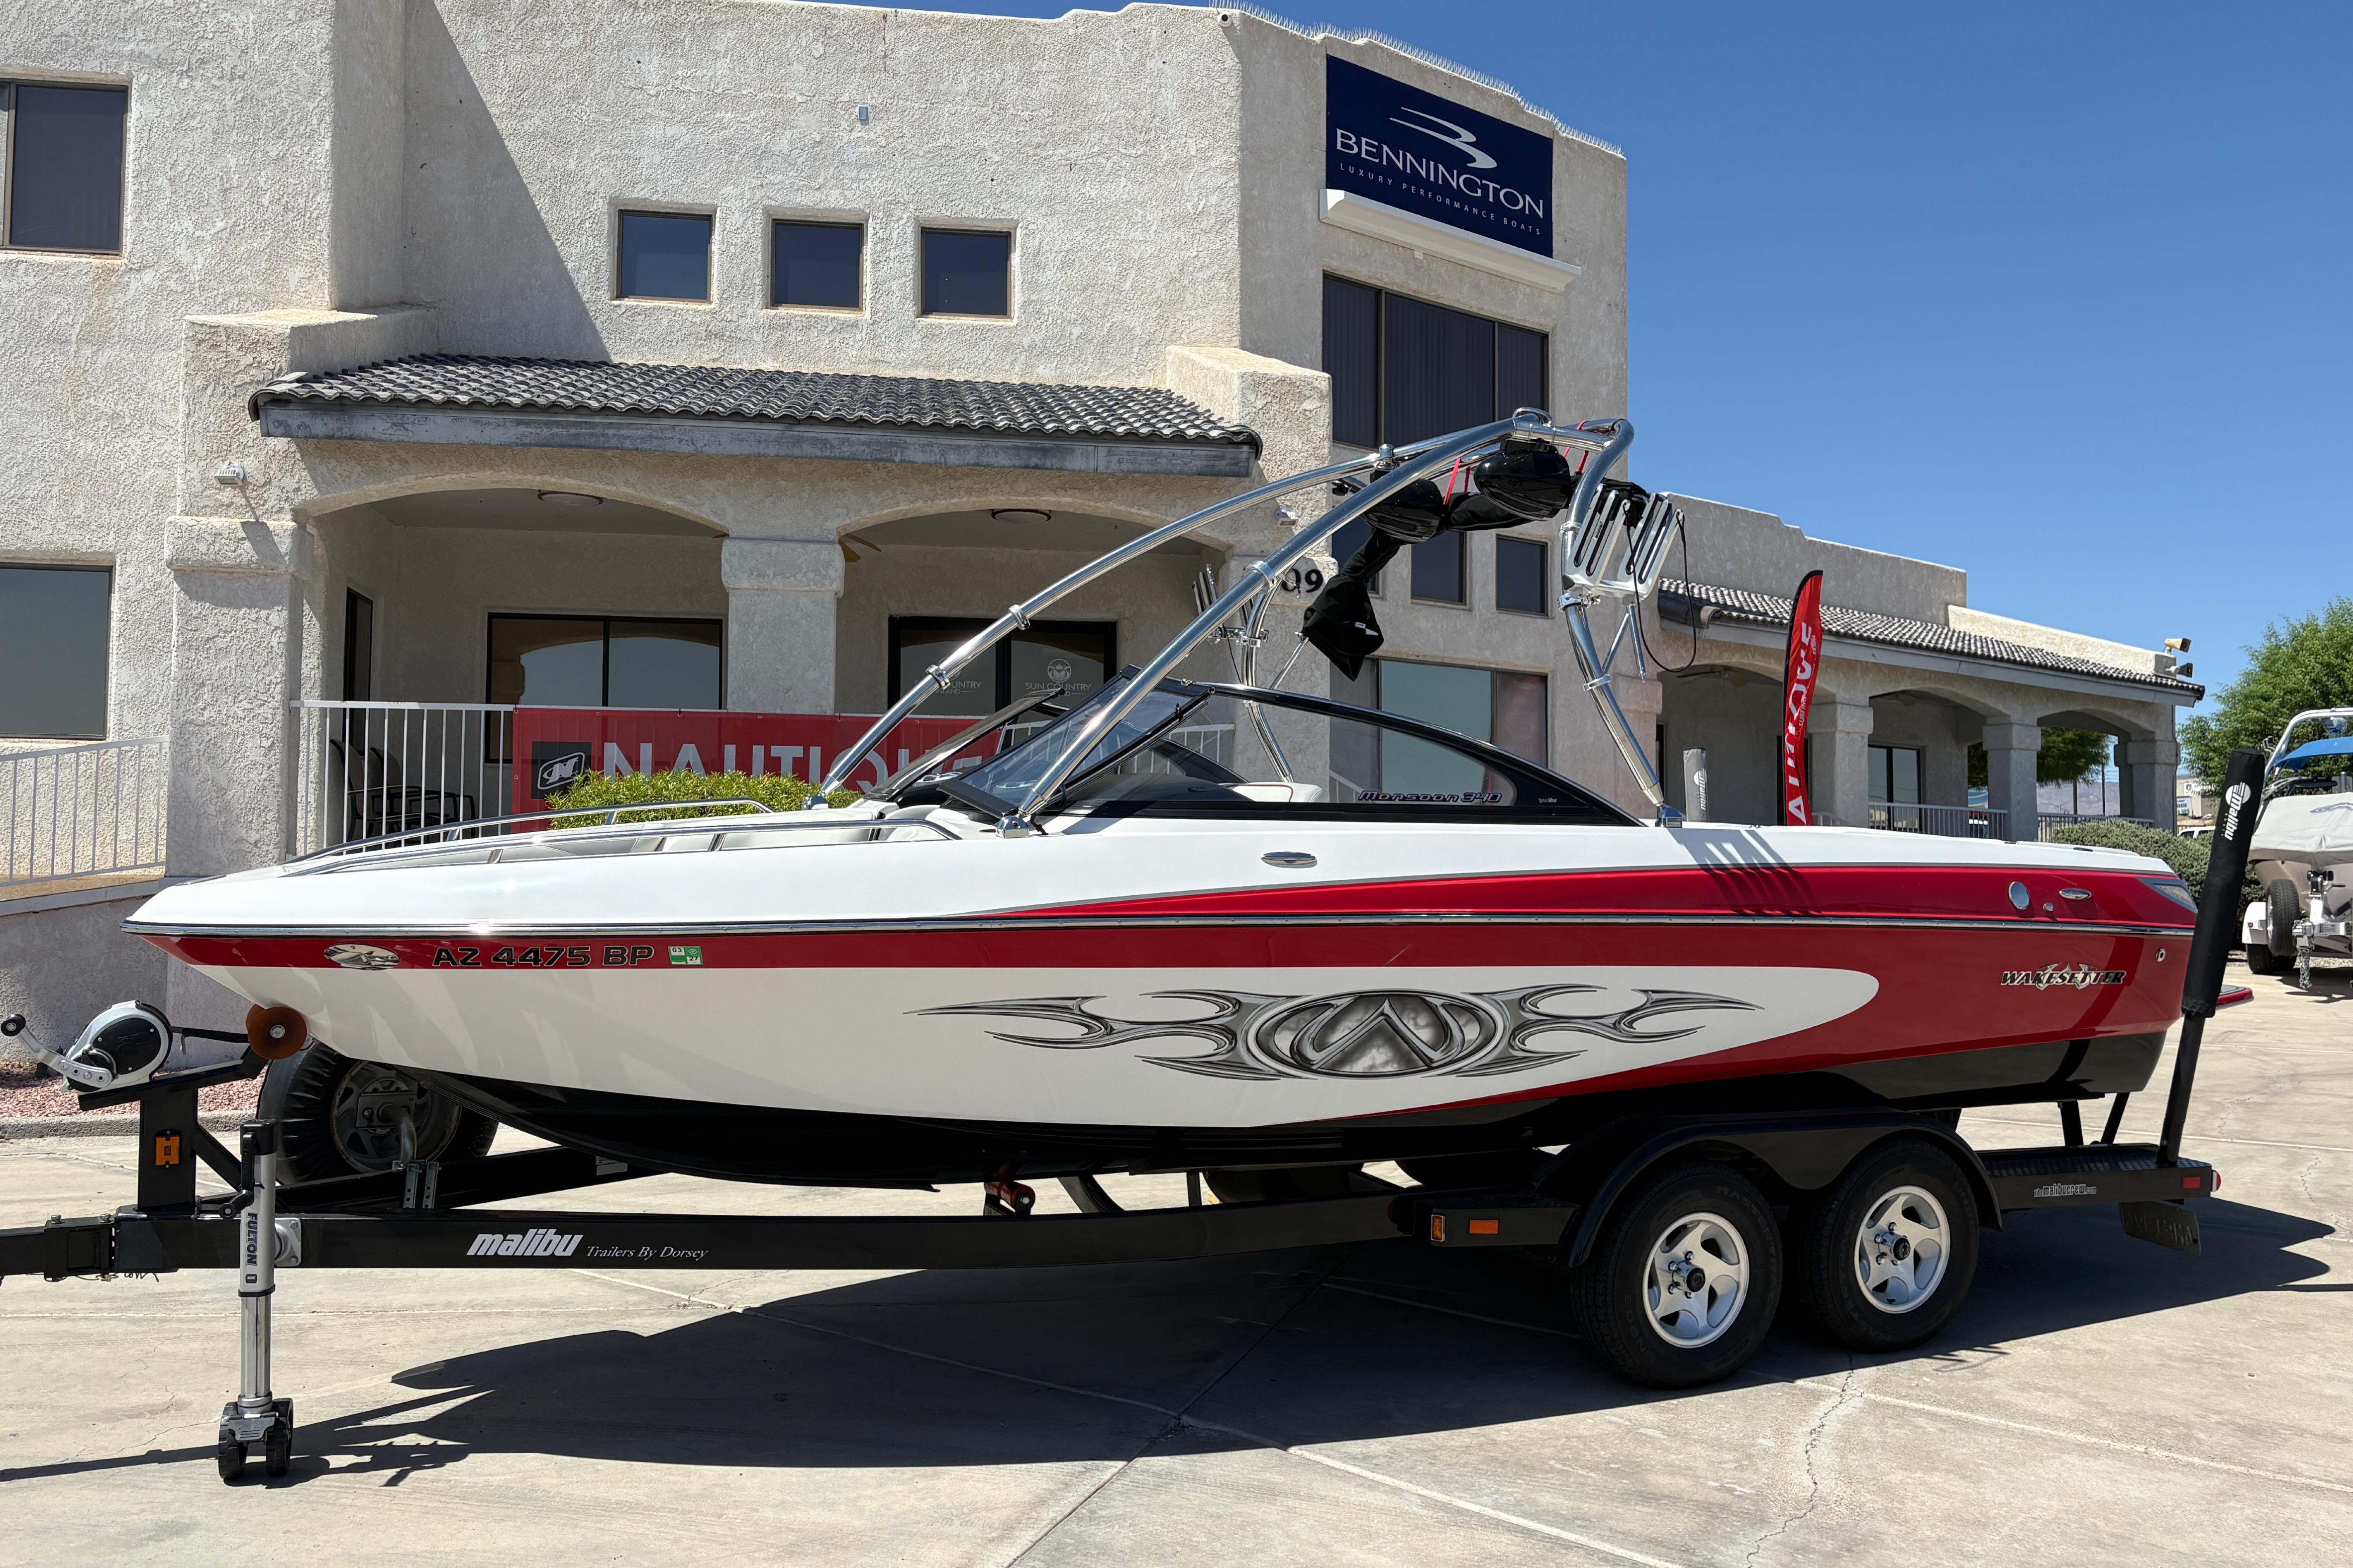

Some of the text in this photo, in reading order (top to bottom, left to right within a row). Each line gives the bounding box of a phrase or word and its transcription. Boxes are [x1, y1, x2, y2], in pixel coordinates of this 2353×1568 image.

[1335, 128, 1543, 219] BENNINGTON
[1340, 163, 1540, 235] LUXURY PERFORMANCE BOATS
[1358, 790, 1503, 803] Monsoon 340
[432, 946, 655, 967] AZ 4475 BP
[2001, 968, 2127, 987] WAKESETTER
[245, 1212, 258, 1266] FULTON
[466, 1229, 709, 1261] malibu Trailers By Dorsey
